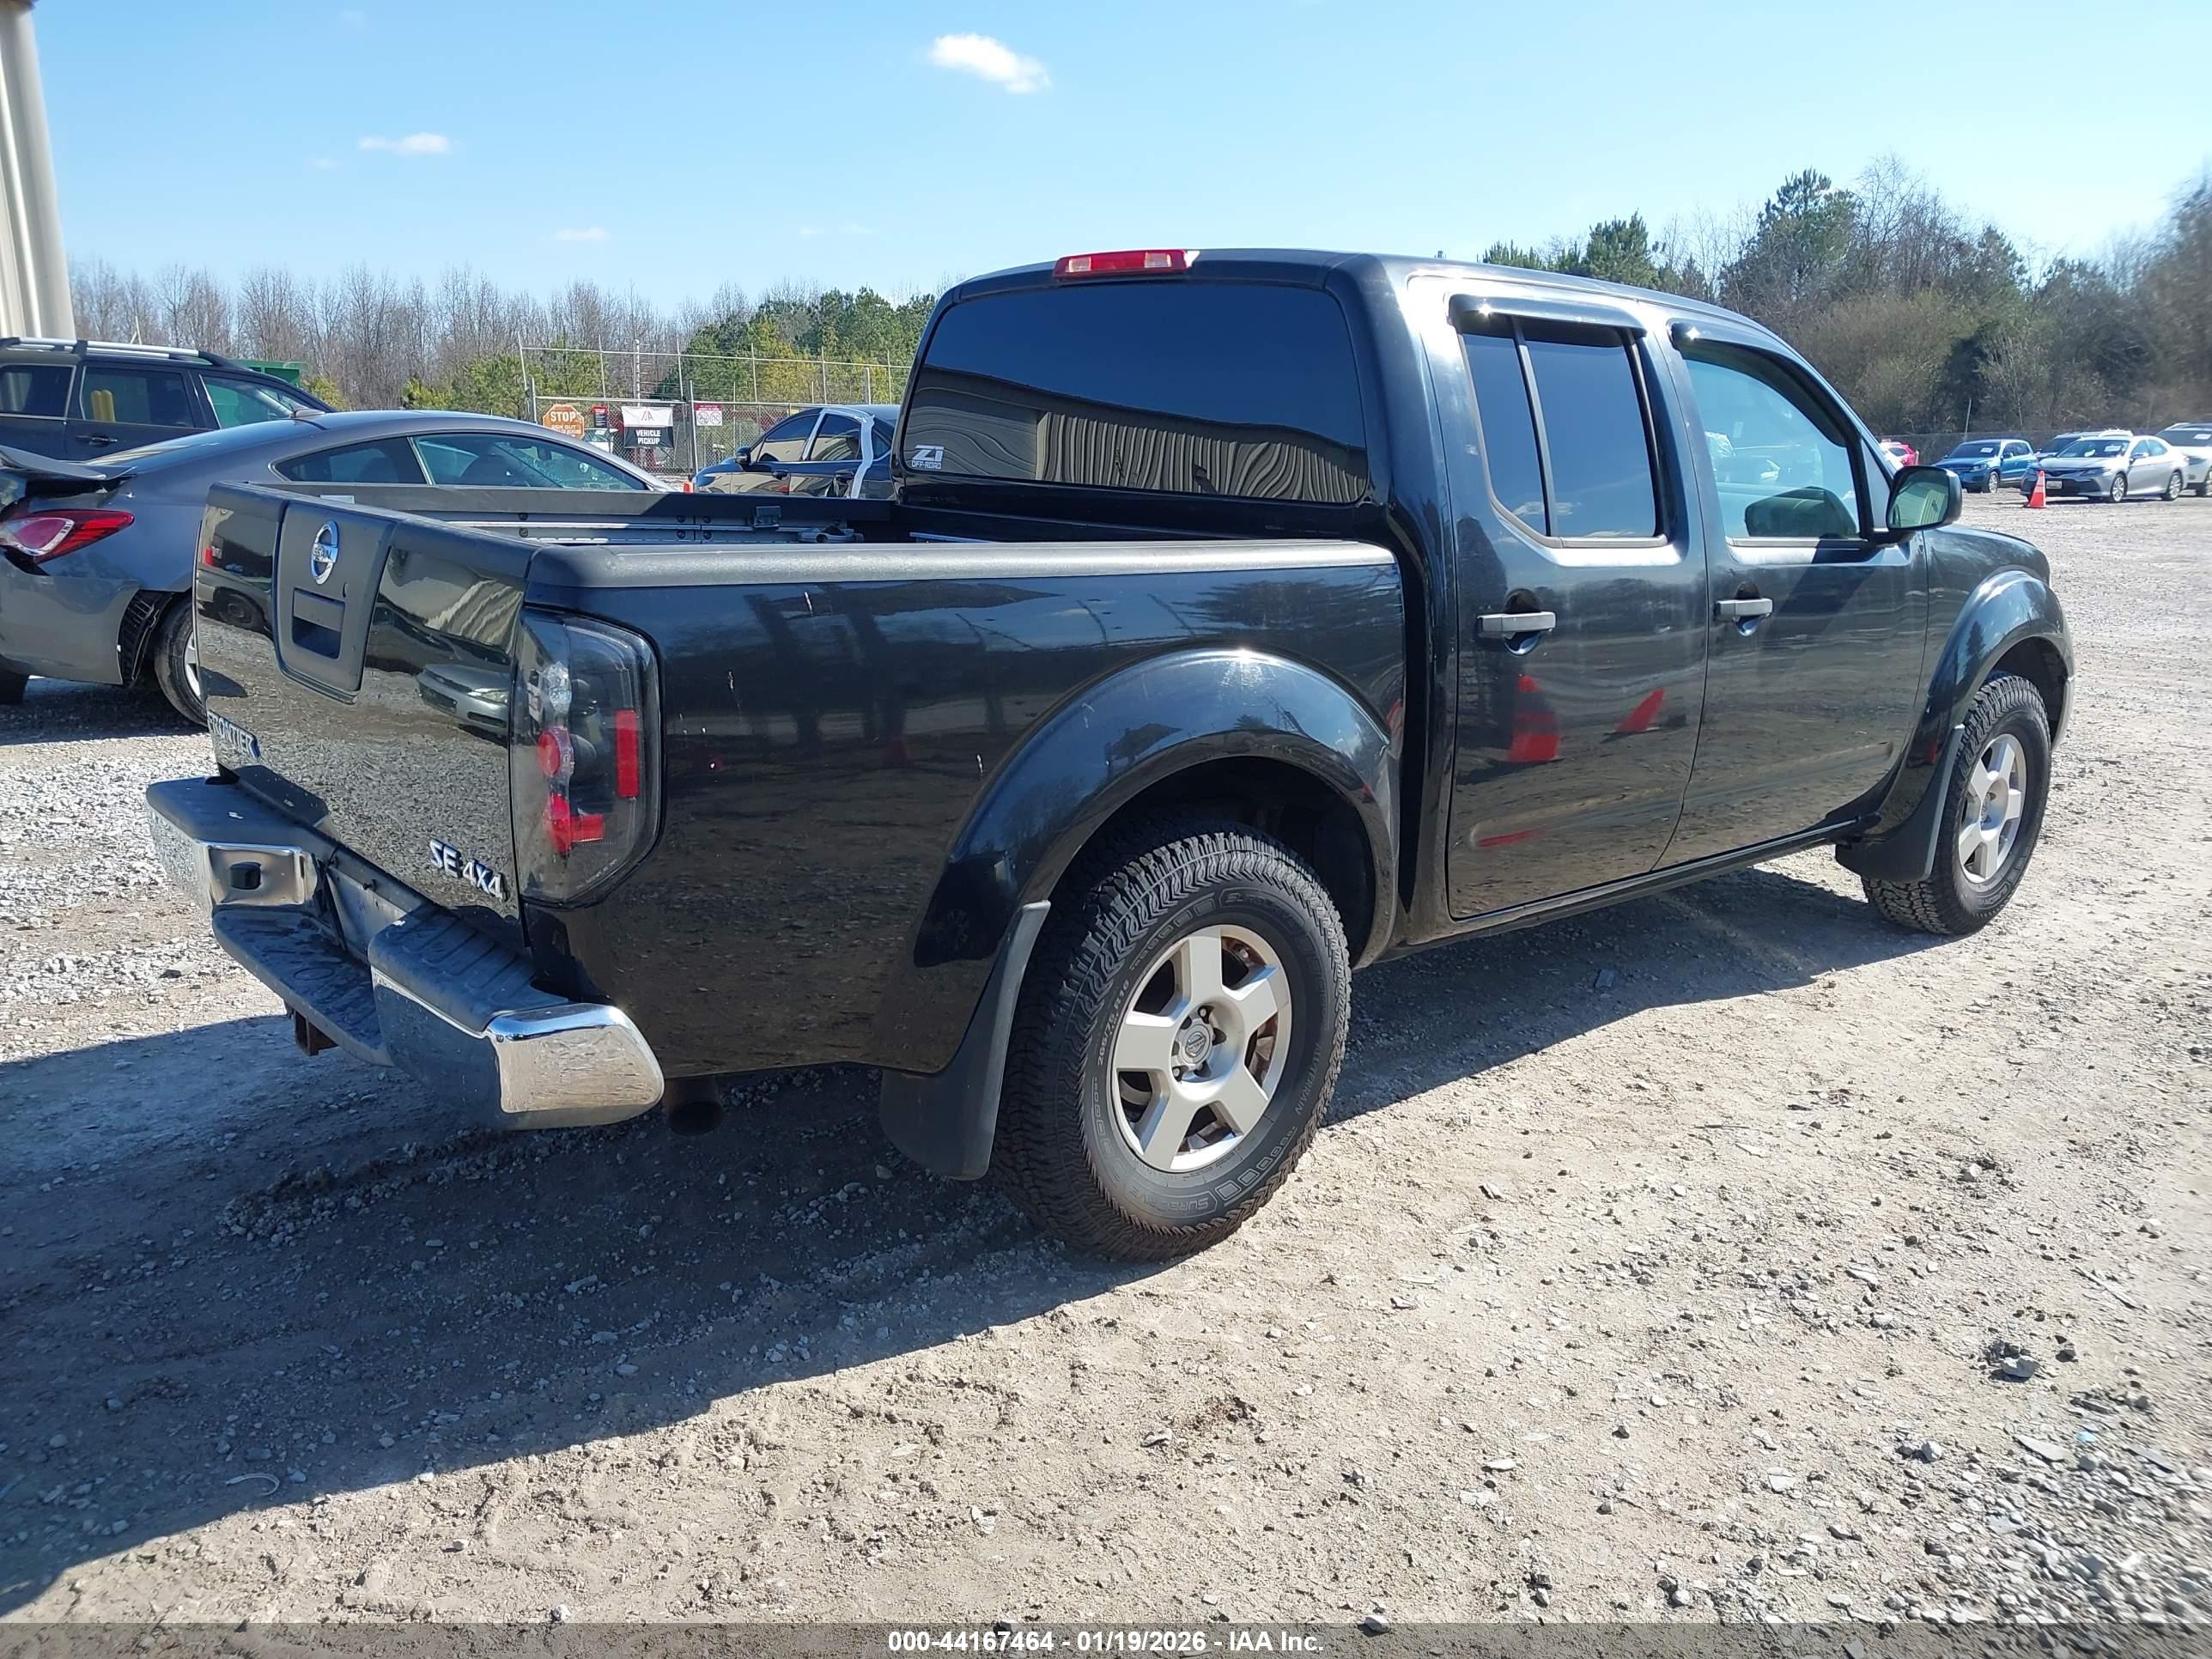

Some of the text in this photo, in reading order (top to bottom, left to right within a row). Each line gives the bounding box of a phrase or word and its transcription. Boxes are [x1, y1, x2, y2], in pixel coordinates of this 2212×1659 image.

[550, 411, 576, 422] STOP
[911, 459, 942, 470] OFF-ROAD
[207, 711, 256, 757] FRONTIER
[430, 839, 459, 879] SE
